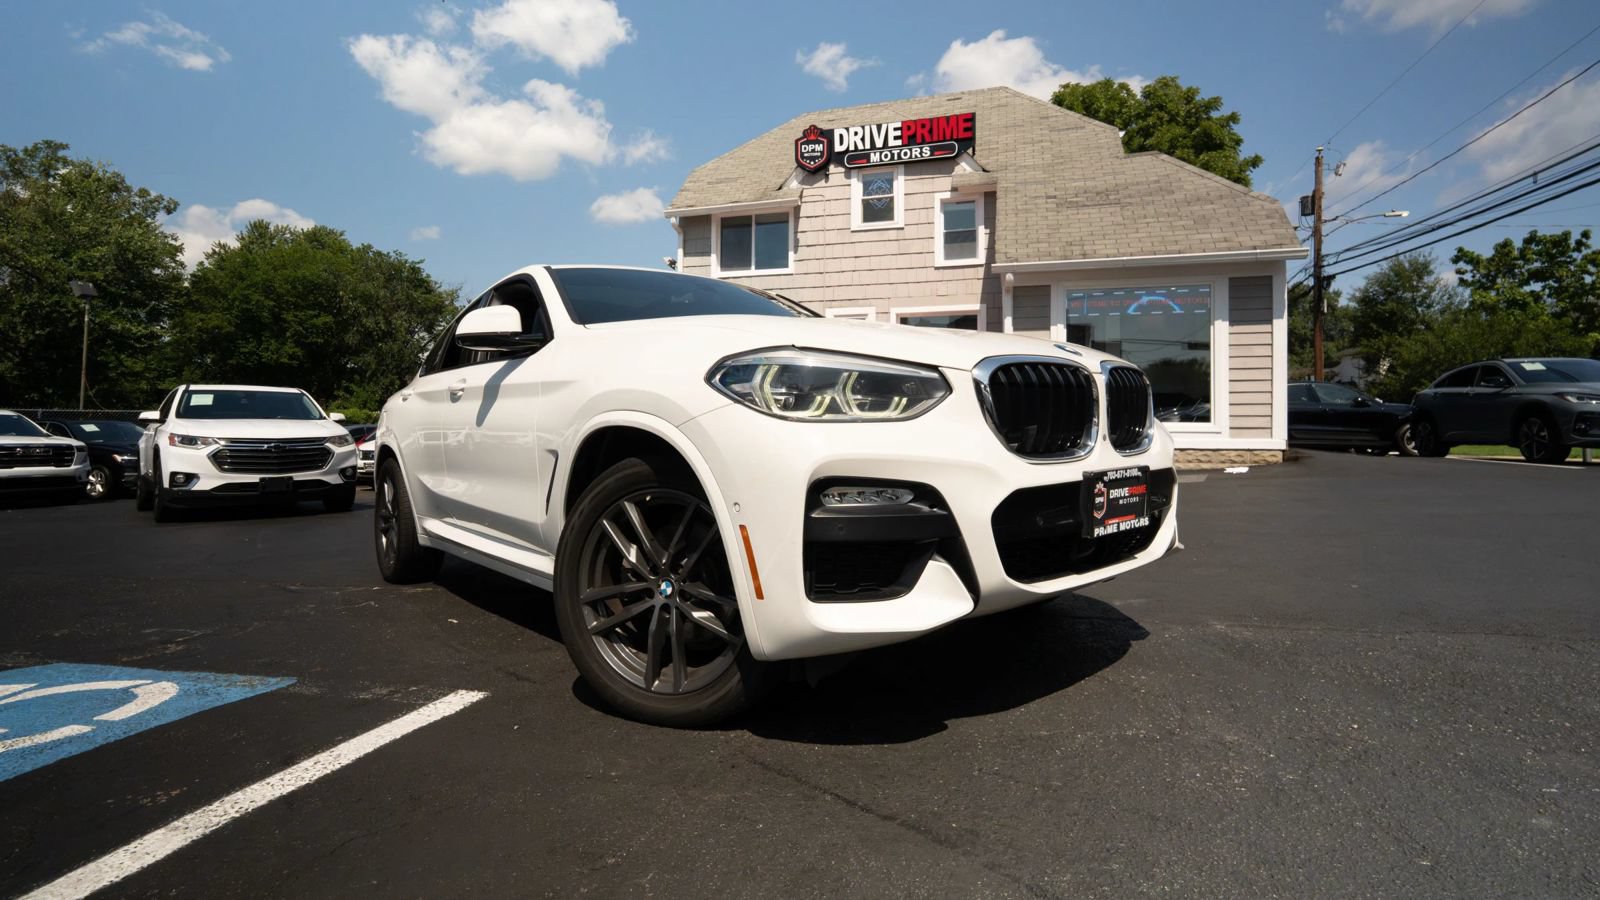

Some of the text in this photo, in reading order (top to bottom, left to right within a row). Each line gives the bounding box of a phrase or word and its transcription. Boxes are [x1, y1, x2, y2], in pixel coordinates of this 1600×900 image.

[801, 143, 823, 153] DPM
[870, 146, 931, 163] MOTORS
[1119, 496, 1139, 505] MOTORS
[1094, 523, 1118, 537] PRIME
[1119, 517, 1149, 531] MOTORS
